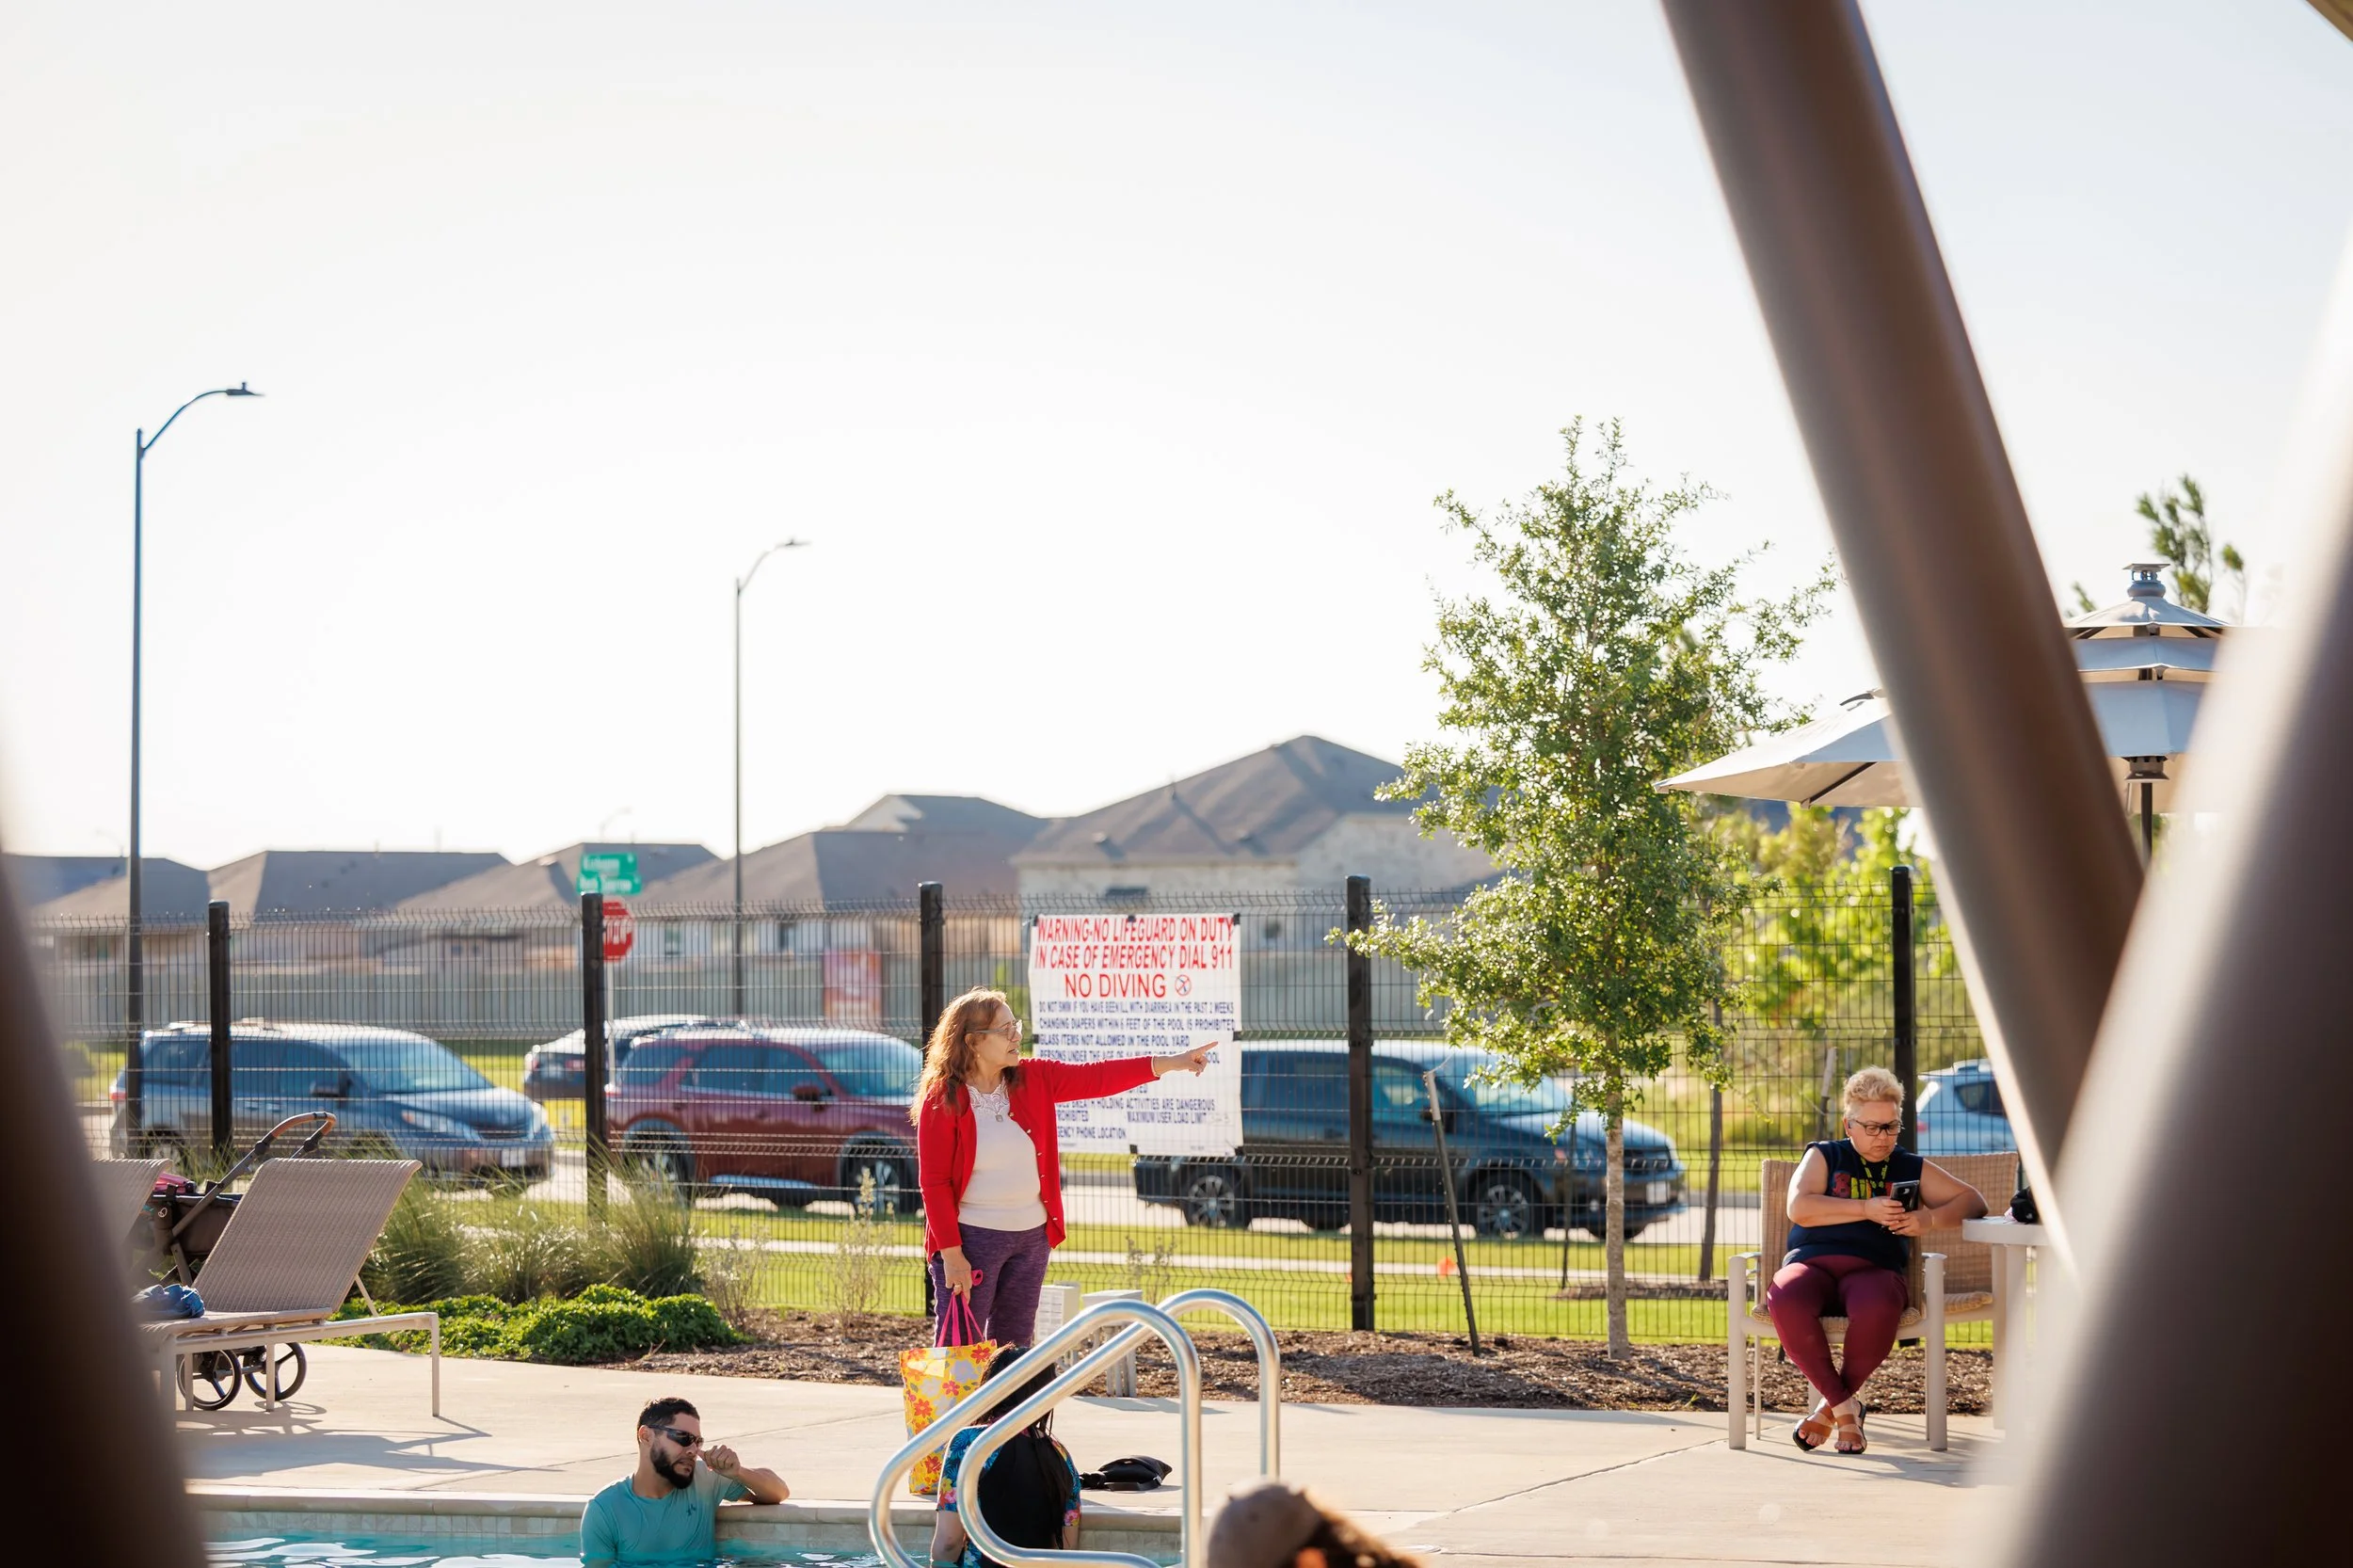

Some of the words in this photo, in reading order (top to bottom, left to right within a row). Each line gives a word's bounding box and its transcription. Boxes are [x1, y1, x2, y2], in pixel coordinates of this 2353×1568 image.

[603, 920, 632, 944] TOP
[1112, 918, 1176, 942] LIFEGUARD
[1180, 918, 1196, 942] ON
[1201, 918, 1234, 942] DUTY
[1035, 945, 1047, 969] IN
[1050, 945, 1080, 969] CASE
[1083, 945, 1098, 969] OF
[1102, 945, 1176, 969] EMERGENCY
[1179, 945, 1207, 969] DIAL
[1211, 945, 1233, 969] 911
[1064, 973, 1093, 998] NO
[1099, 973, 1166, 998] DIVING
[1048, 1000, 1057, 1013] NOT
[1080, 1000, 1089, 1013] YOU
[1091, 1000, 1104, 1013] HAVE
[1106, 1000, 1119, 1013] BEEN
[1129, 1000, 1143, 1013] WITH
[1181, 1001, 1192, 1014] THE
[1194, 1001, 1207, 1014] PAST
[1215, 1001, 1234, 1014] WEEKS
[1039, 1017, 1069, 1030] CHANGING
[1071, 1017, 1096, 1030] DIAPERS
[1097, 1017, 1118, 1030] WITHIN
[1126, 1017, 1141, 1030] FEET
[1144, 1018, 1151, 1031] OF
[1154, 1018, 1165, 1031] THE
[1168, 1018, 1184, 1031] POOL
[1187, 1018, 1193, 1031] IS
[1195, 1018, 1235, 1031] PROHIBITED
[1039, 1034, 1059, 1046] GLASS
[1062, 1034, 1079, 1046] ITEMS
[1081, 1034, 1094, 1046] NOT
[1096, 1034, 1126, 1046] ALLOWED
[1128, 1035, 1134, 1047] IN
[1137, 1035, 1149, 1047] THE
[1151, 1035, 1169, 1047] POOL
[1172, 1035, 1190, 1047] YARD
[1039, 1050, 1066, 1061] PERSONS
[1068, 1050, 1088, 1062] UNDER
[1206, 1052, 1220, 1064] OOL
[1097, 1098, 1125, 1110] HOLDING
[1127, 1098, 1160, 1110] ACTIVITIES
[1162, 1098, 1175, 1111] ARE
[1176, 1099, 1215, 1111] DANGEROUS
[1058, 1110, 1089, 1122] ROHIBITED
[1157, 1112, 1172, 1124] USER
[1174, 1112, 1189, 1124] LOAD
[1077, 1127, 1096, 1139] PHONE
[1097, 1128, 1127, 1140] LOCATION
